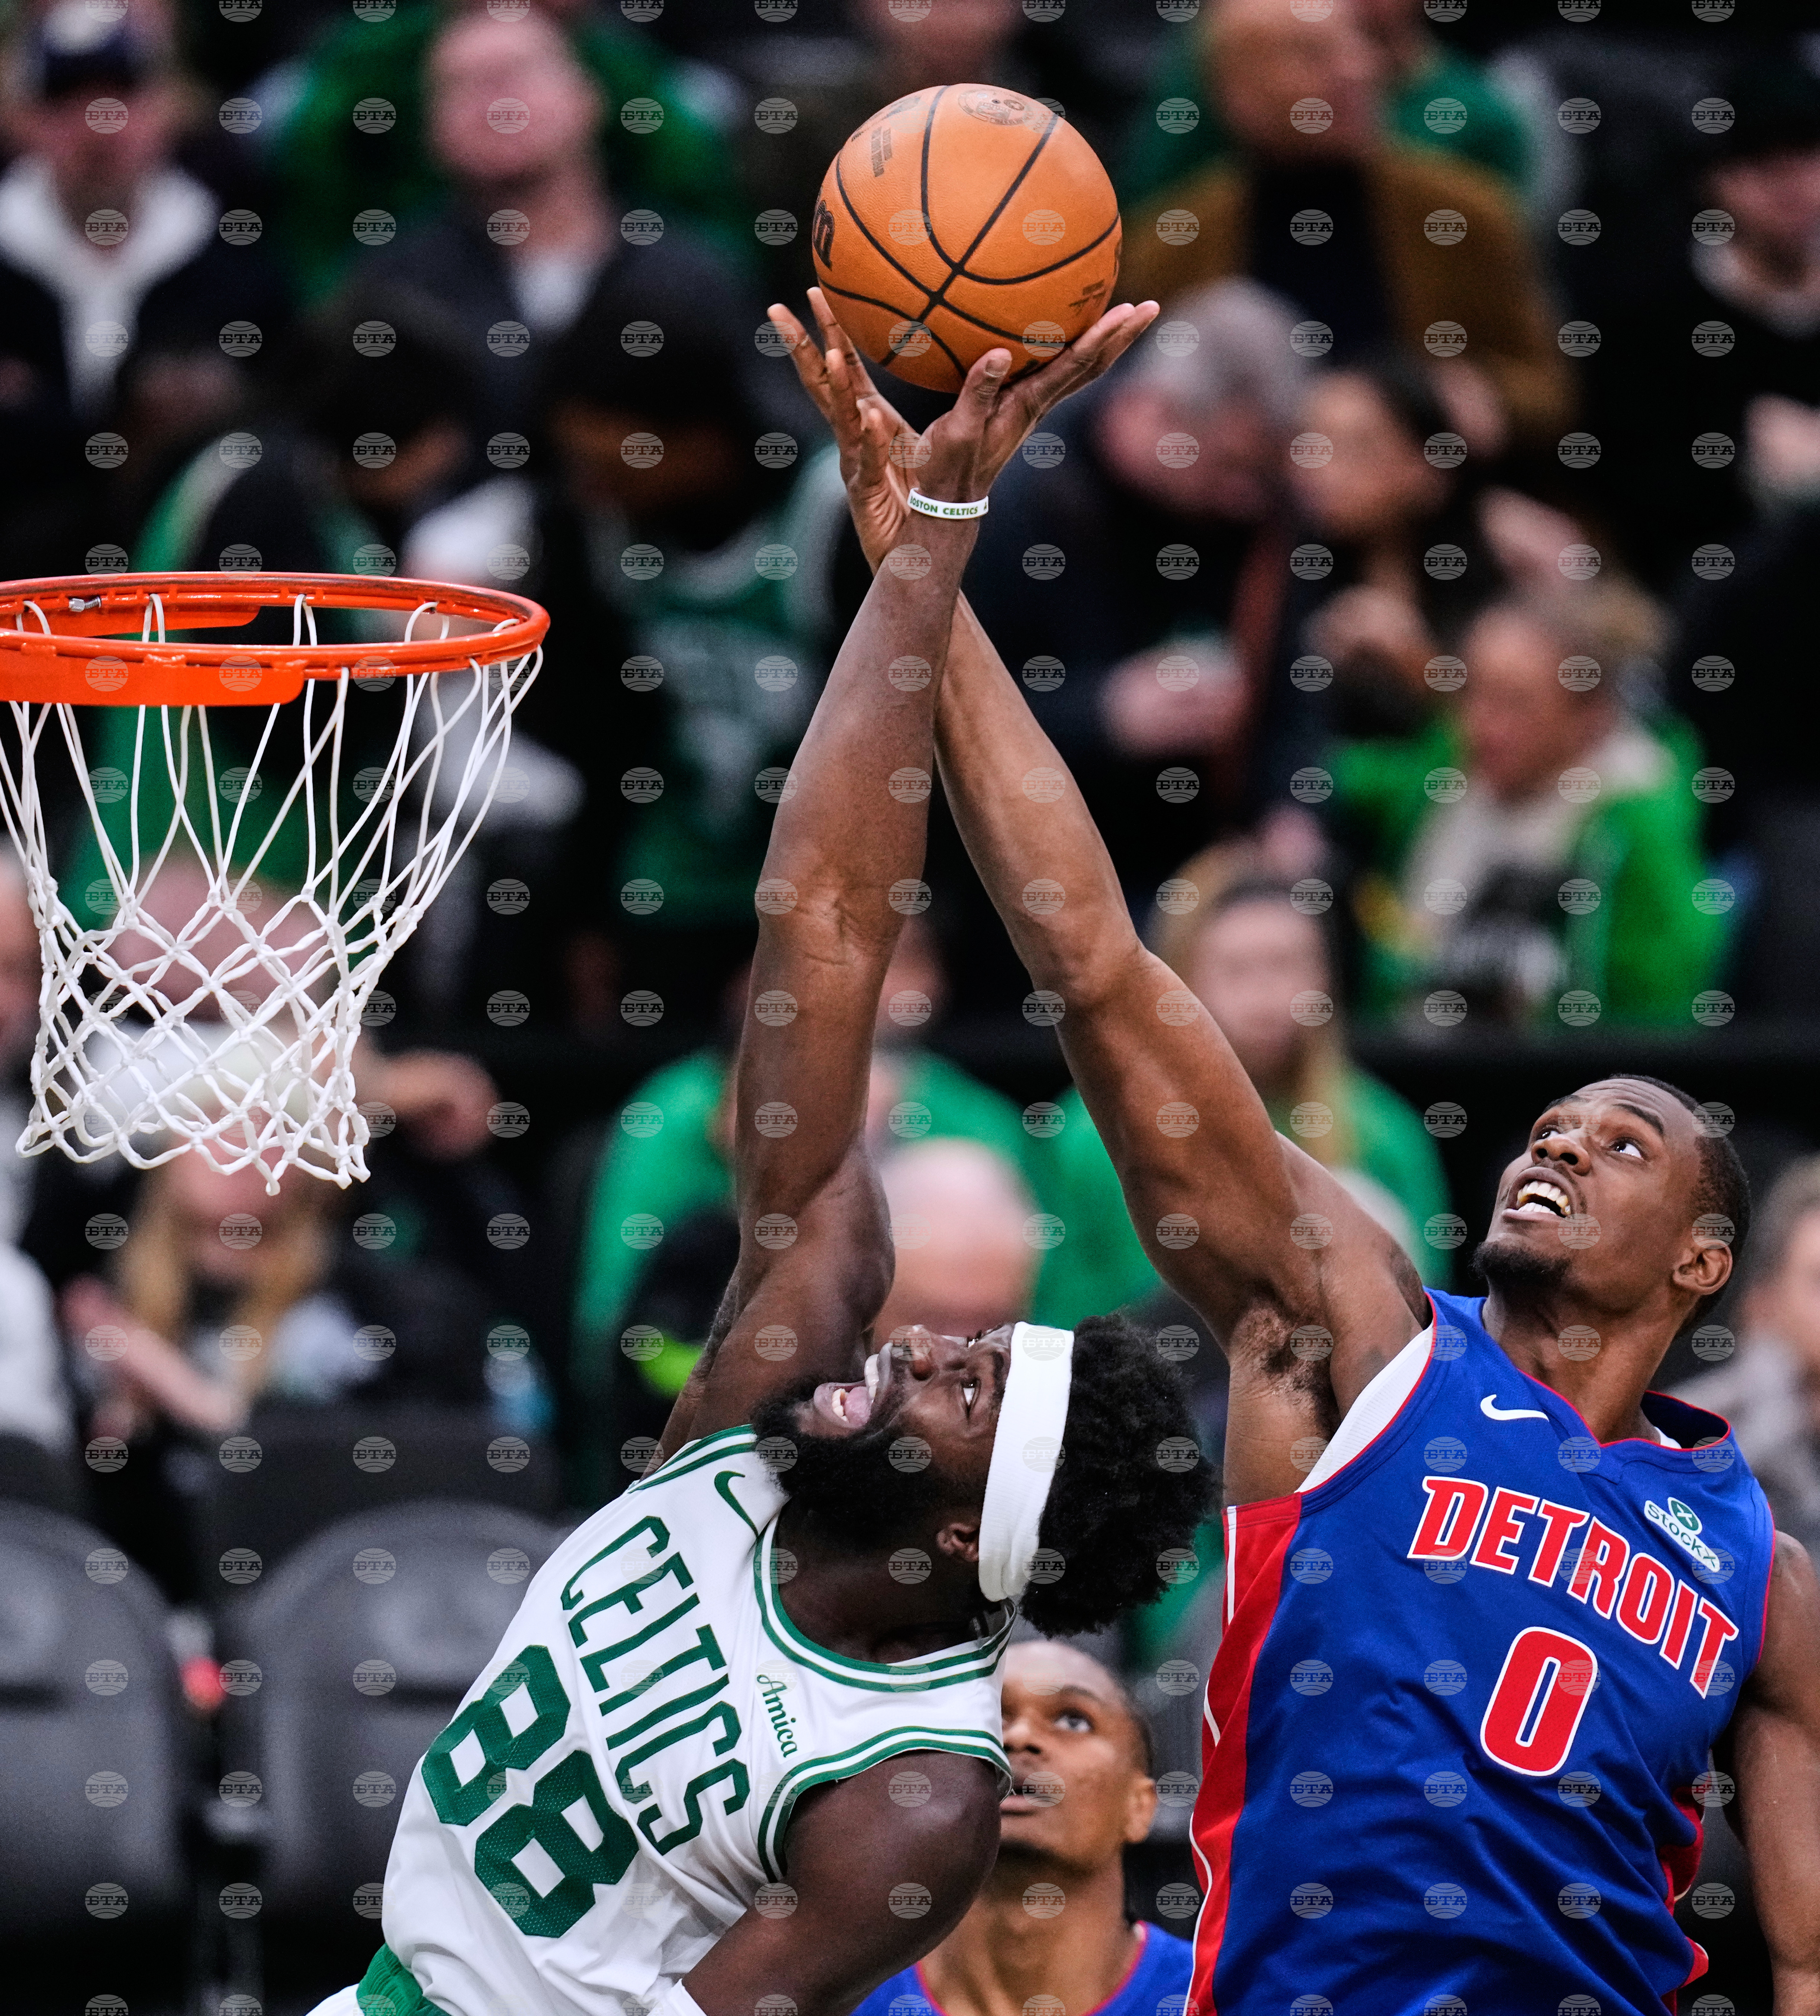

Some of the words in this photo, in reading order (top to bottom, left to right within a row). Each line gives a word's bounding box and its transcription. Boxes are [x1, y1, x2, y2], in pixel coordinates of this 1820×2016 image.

[943, 506, 978, 515] CELTICS
[1407, 1476, 1739, 1699] DETROIT
[561, 1515, 750, 1855] CELTICS
[757, 1674, 798, 1758] Amica
[1480, 1626, 1597, 1776] 0
[421, 1644, 639, 1938] 88
